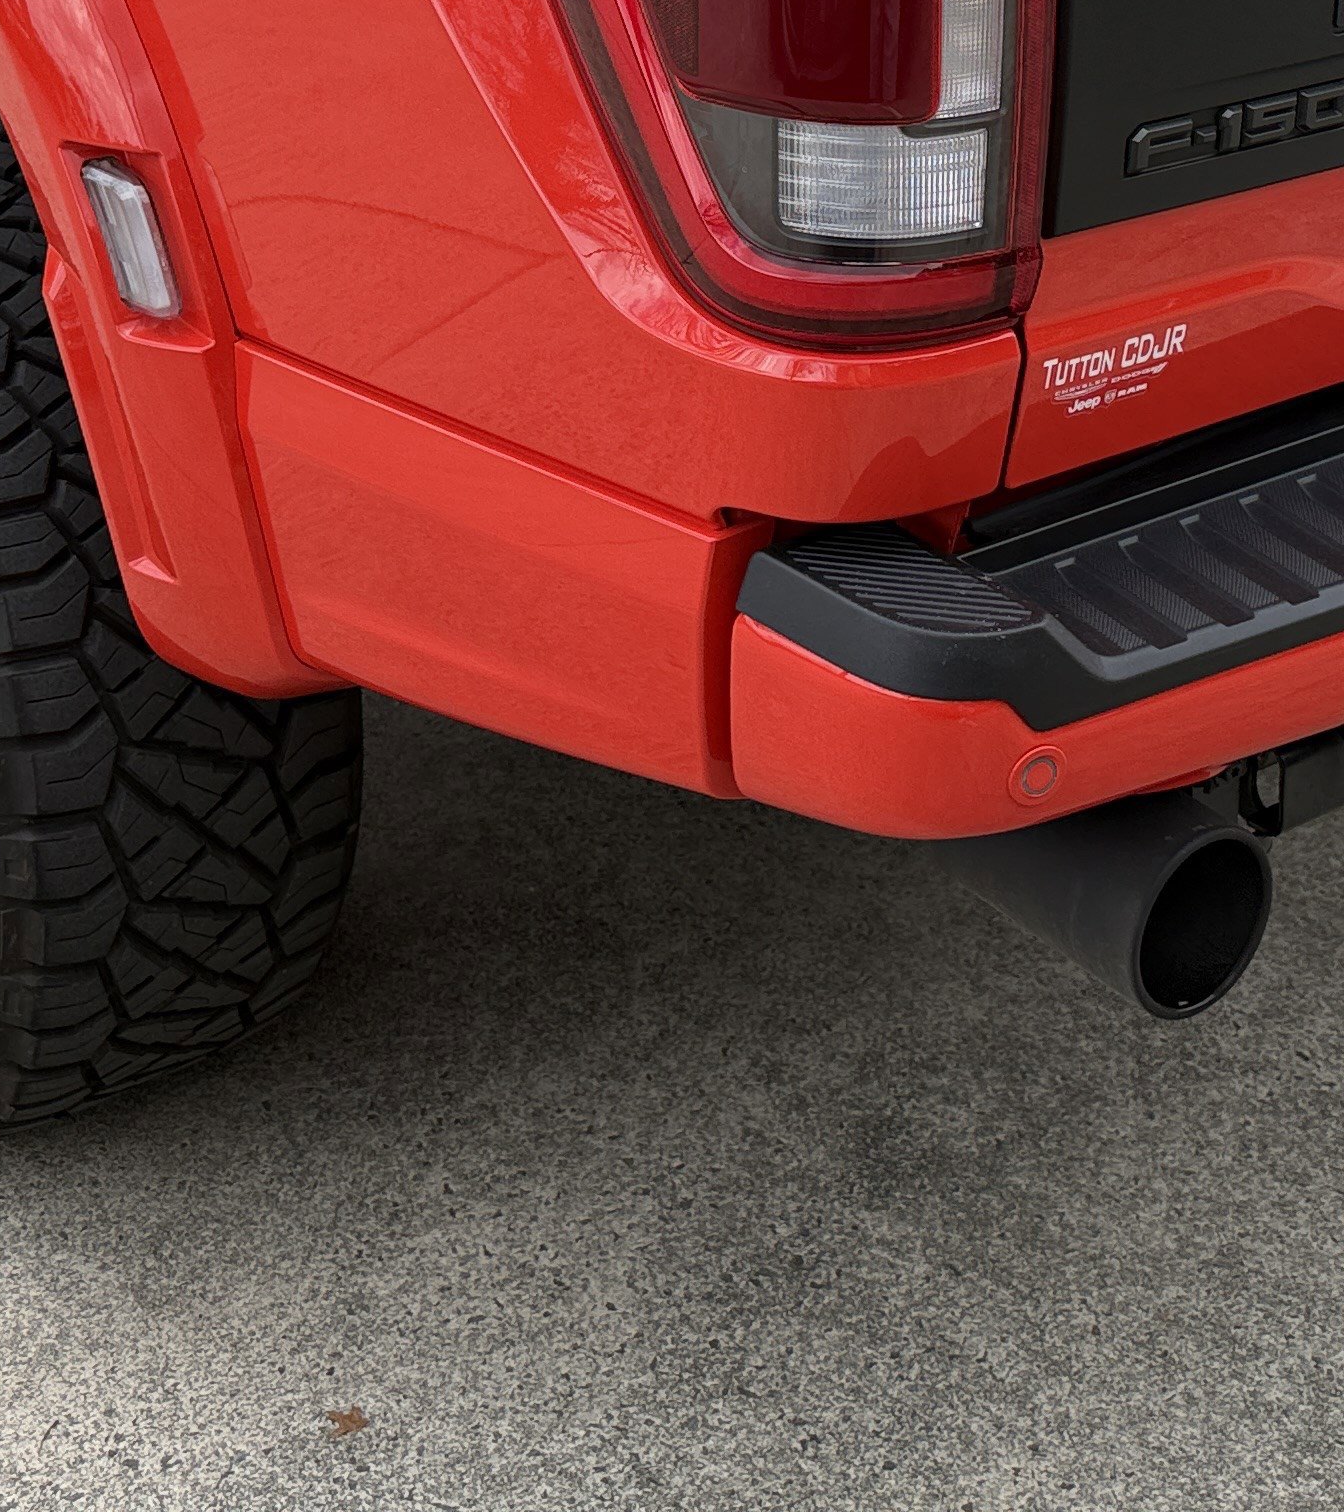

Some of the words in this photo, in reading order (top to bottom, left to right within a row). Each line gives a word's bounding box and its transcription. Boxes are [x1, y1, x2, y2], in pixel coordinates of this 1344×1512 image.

[1043, 347, 1115, 389] TUTTON
[1121, 324, 1187, 368] CDJR
[1068, 395, 1102, 414] Jeep
[1117, 383, 1148, 398] RAM
